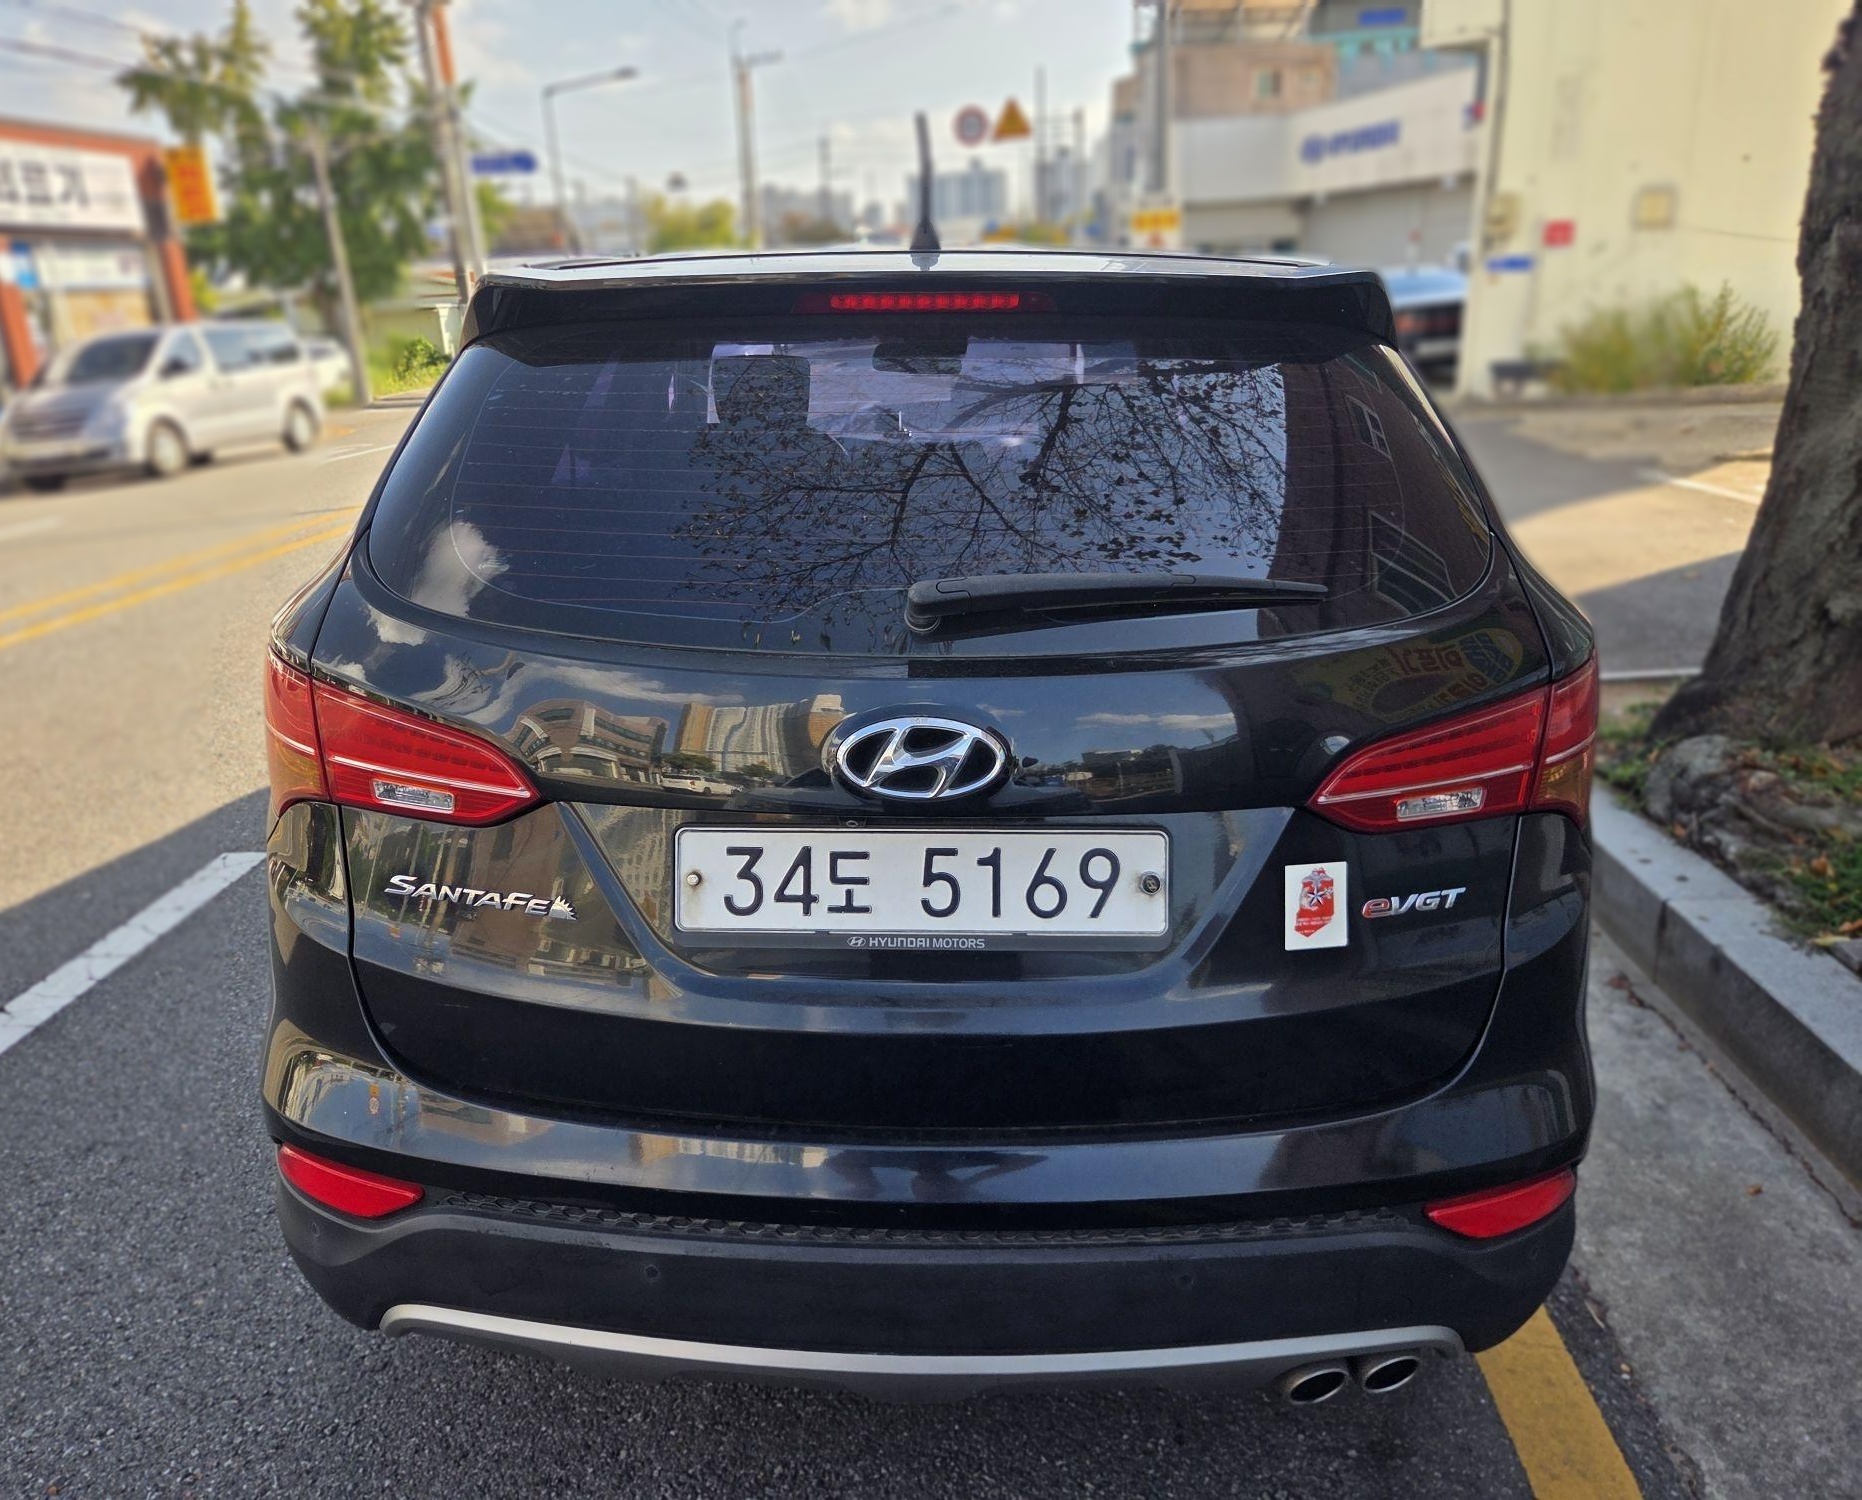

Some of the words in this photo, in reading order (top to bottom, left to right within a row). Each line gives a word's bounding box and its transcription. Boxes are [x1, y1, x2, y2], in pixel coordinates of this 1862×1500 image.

[724, 846, 872, 916] 34도
[921, 847, 1120, 918] 5169
[1362, 887, 1466, 919] eVGT
[868, 937, 930, 949] HYUNDAI
[932, 937, 986, 949] MOTORS
